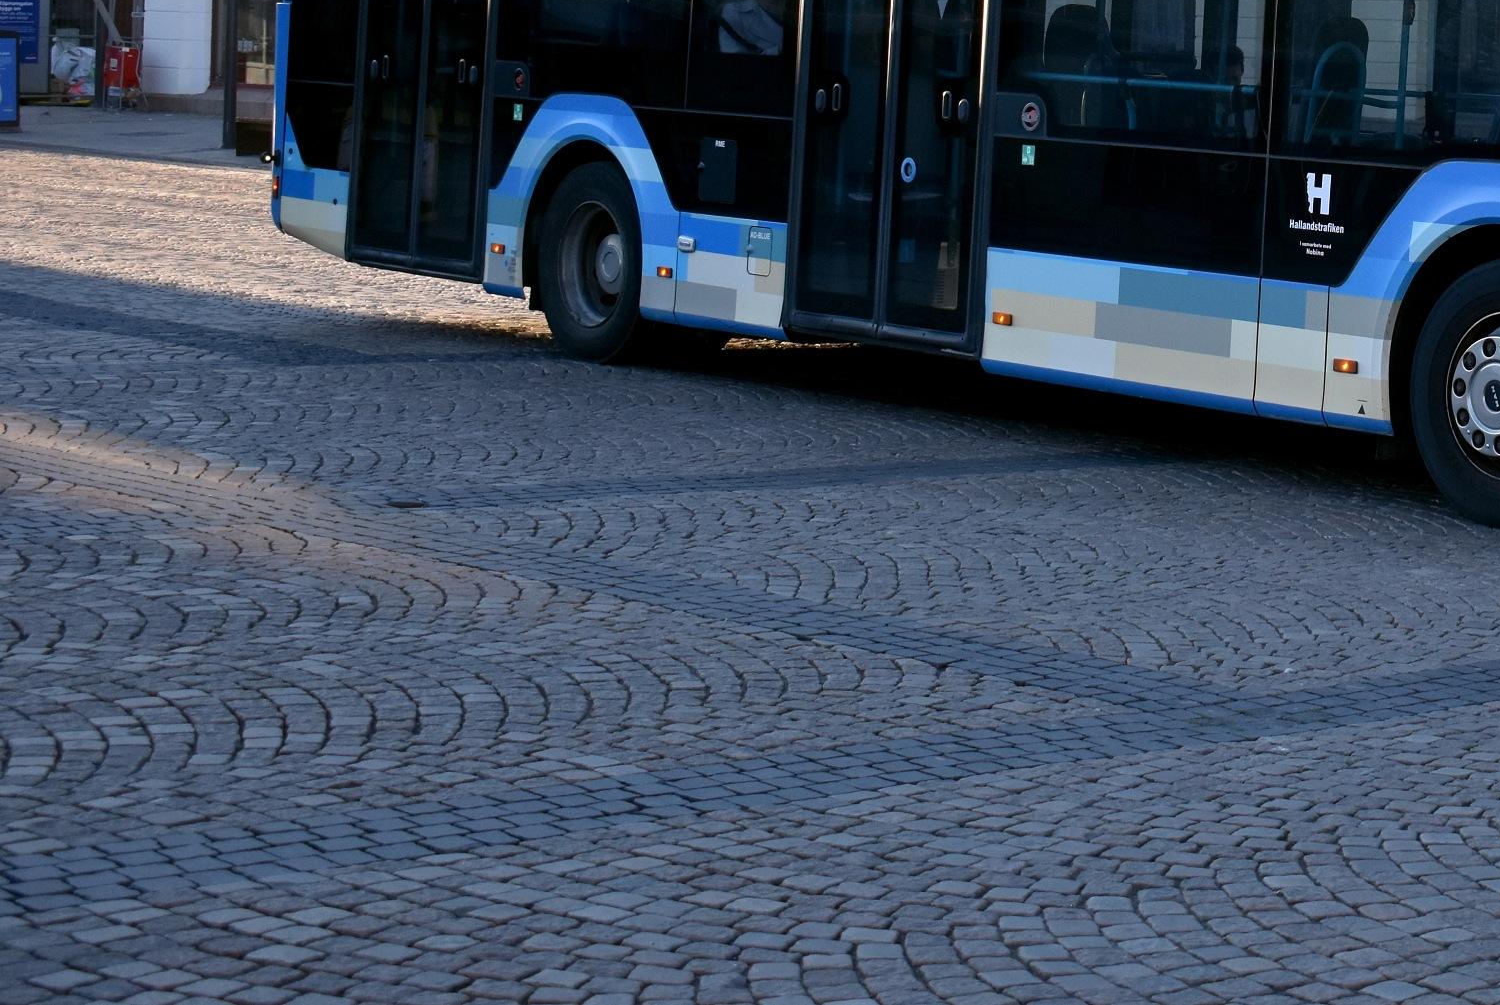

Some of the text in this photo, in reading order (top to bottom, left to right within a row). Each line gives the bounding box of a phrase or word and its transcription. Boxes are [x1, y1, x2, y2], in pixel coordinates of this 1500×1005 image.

[715, 140, 726, 148] RME
[1306, 172, 1331, 215] H
[1289, 219, 1344, 234] Hallandstrafiken
